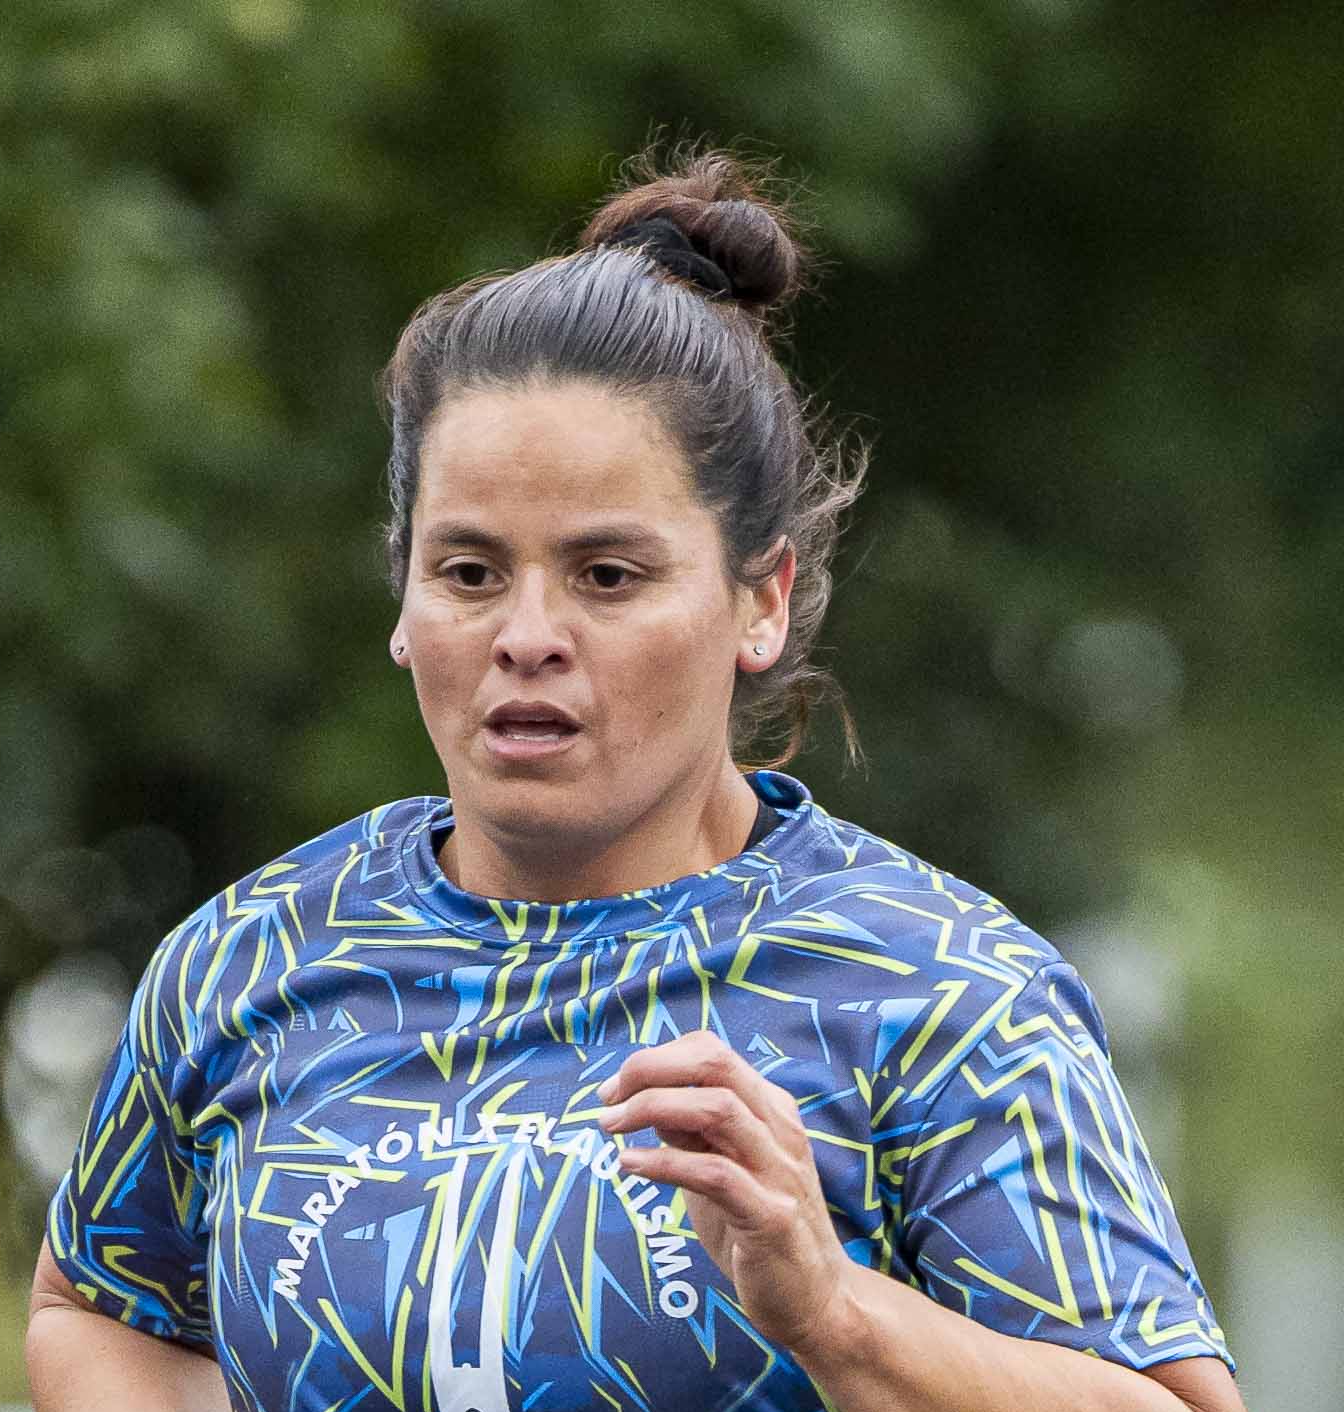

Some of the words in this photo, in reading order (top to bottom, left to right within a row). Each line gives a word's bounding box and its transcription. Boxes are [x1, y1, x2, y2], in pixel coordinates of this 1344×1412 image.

[273, 1118, 454, 1301] MARATÓN
[475, 1112, 506, 1144] X
[559, 1127, 699, 1319] AUTISMO
